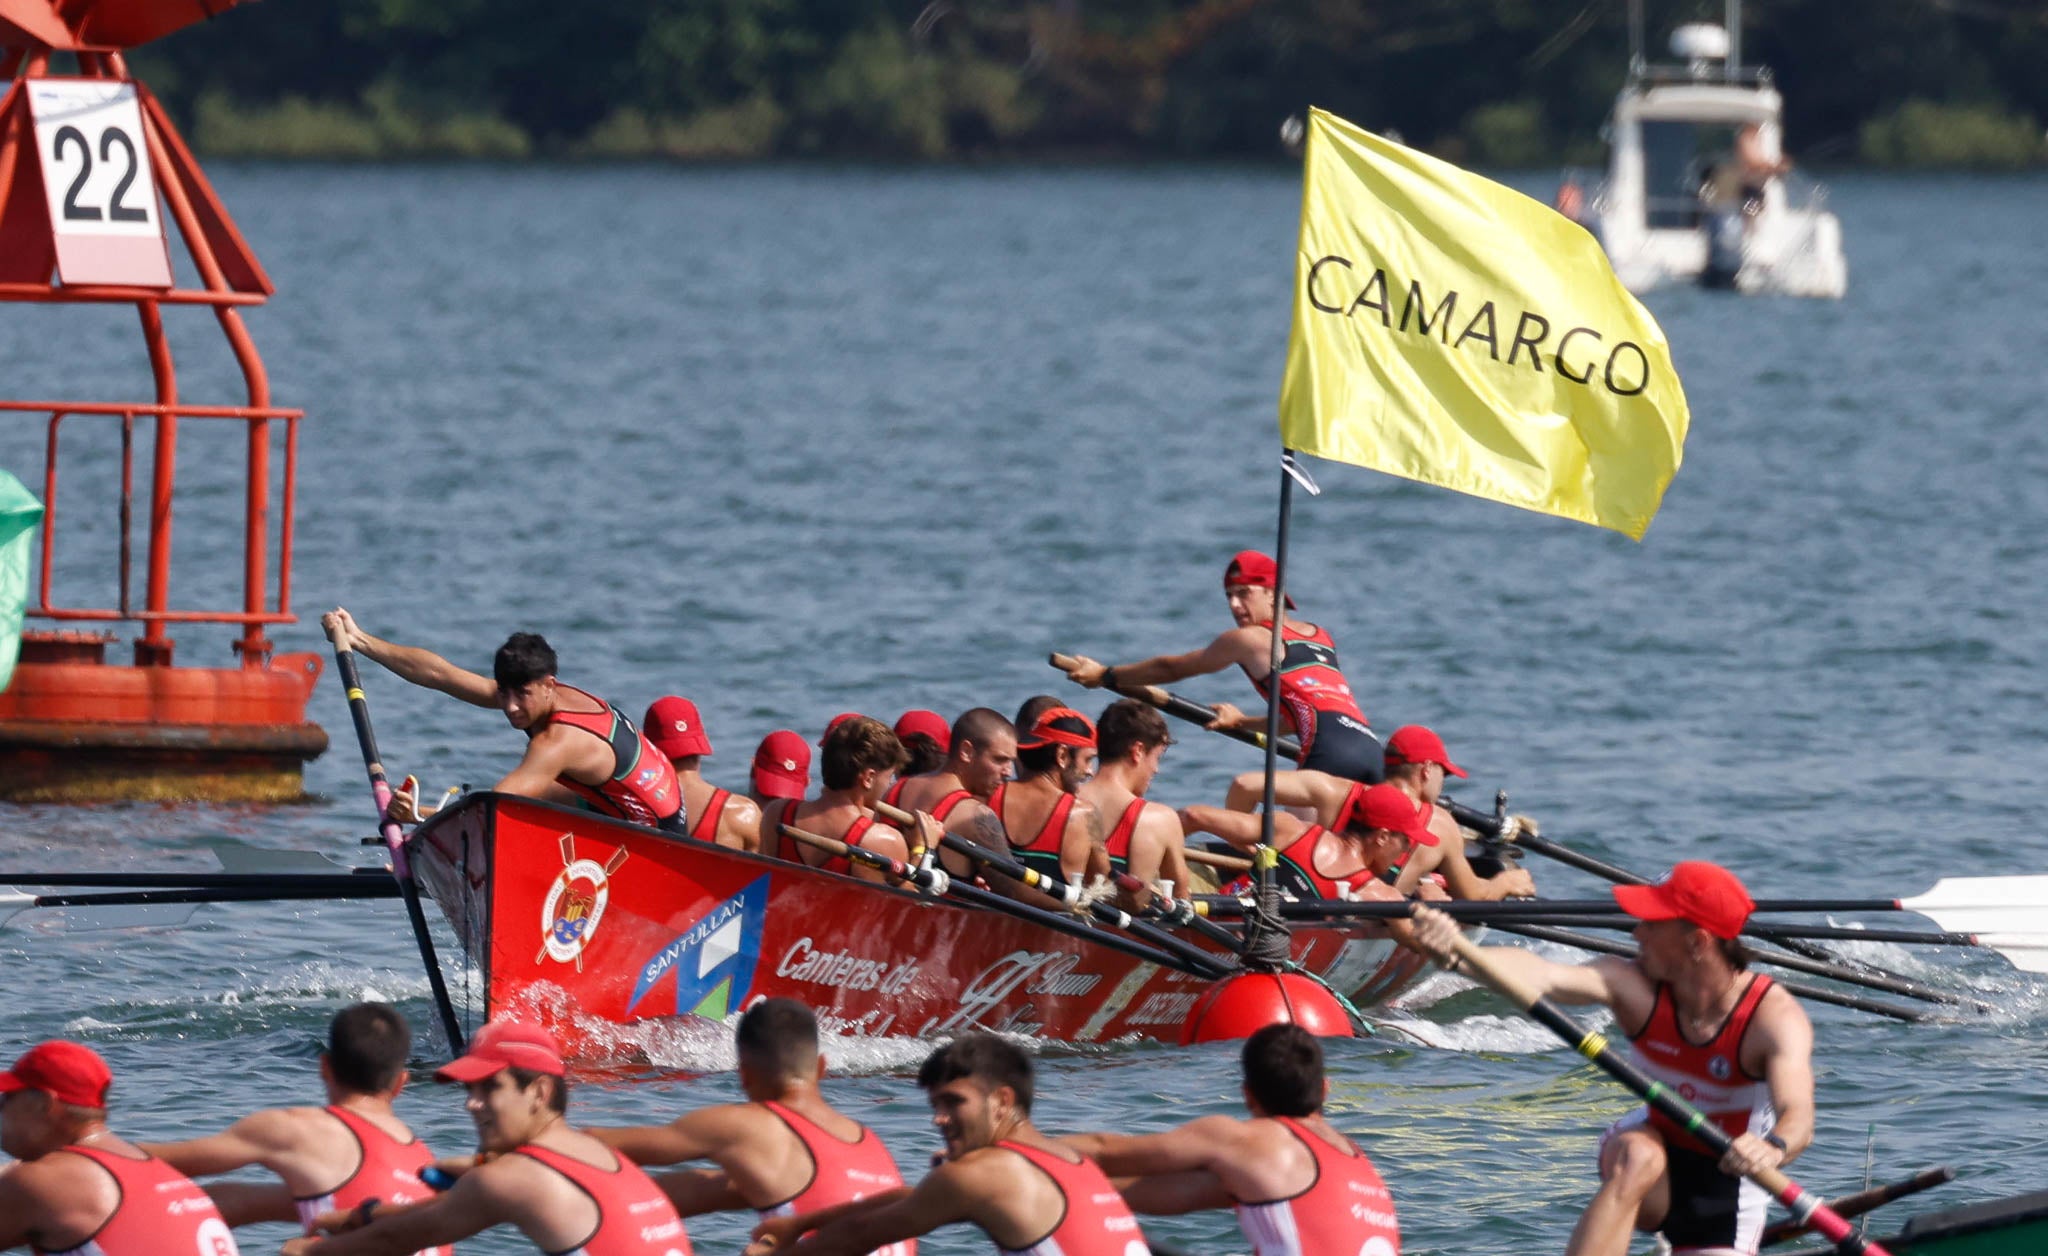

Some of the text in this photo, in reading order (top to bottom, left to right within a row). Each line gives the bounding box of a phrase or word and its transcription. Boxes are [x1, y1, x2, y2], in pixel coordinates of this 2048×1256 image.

[53, 125, 149, 222] 22
[1307, 255, 1650, 396] CAMARGO
[776, 936, 920, 995] Canteras de
